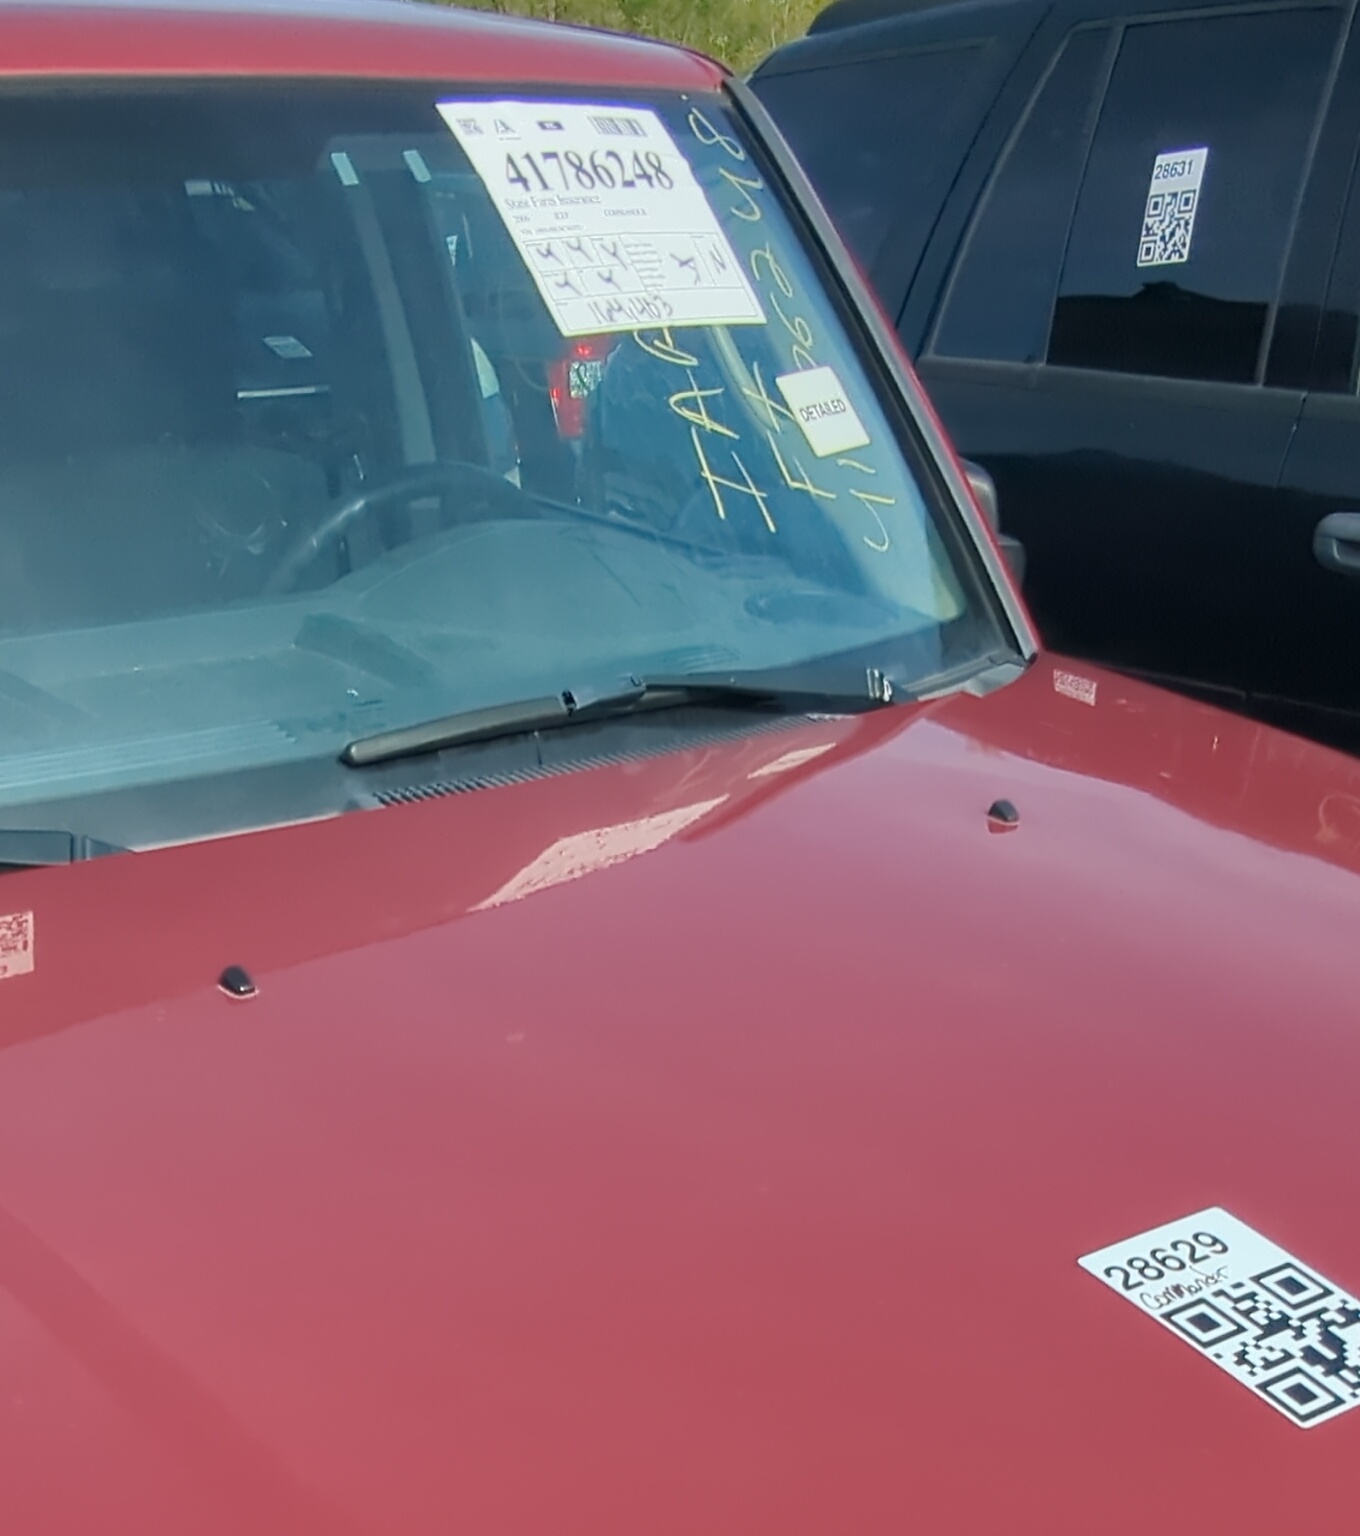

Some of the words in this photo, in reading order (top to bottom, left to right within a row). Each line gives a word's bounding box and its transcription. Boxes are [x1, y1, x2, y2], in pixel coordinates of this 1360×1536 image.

[505, 150, 674, 191] 41786248
[1154, 159, 1194, 180] 28631
[799, 399, 846, 422] DETAILED
[1102, 1231, 1230, 1292] 28629
